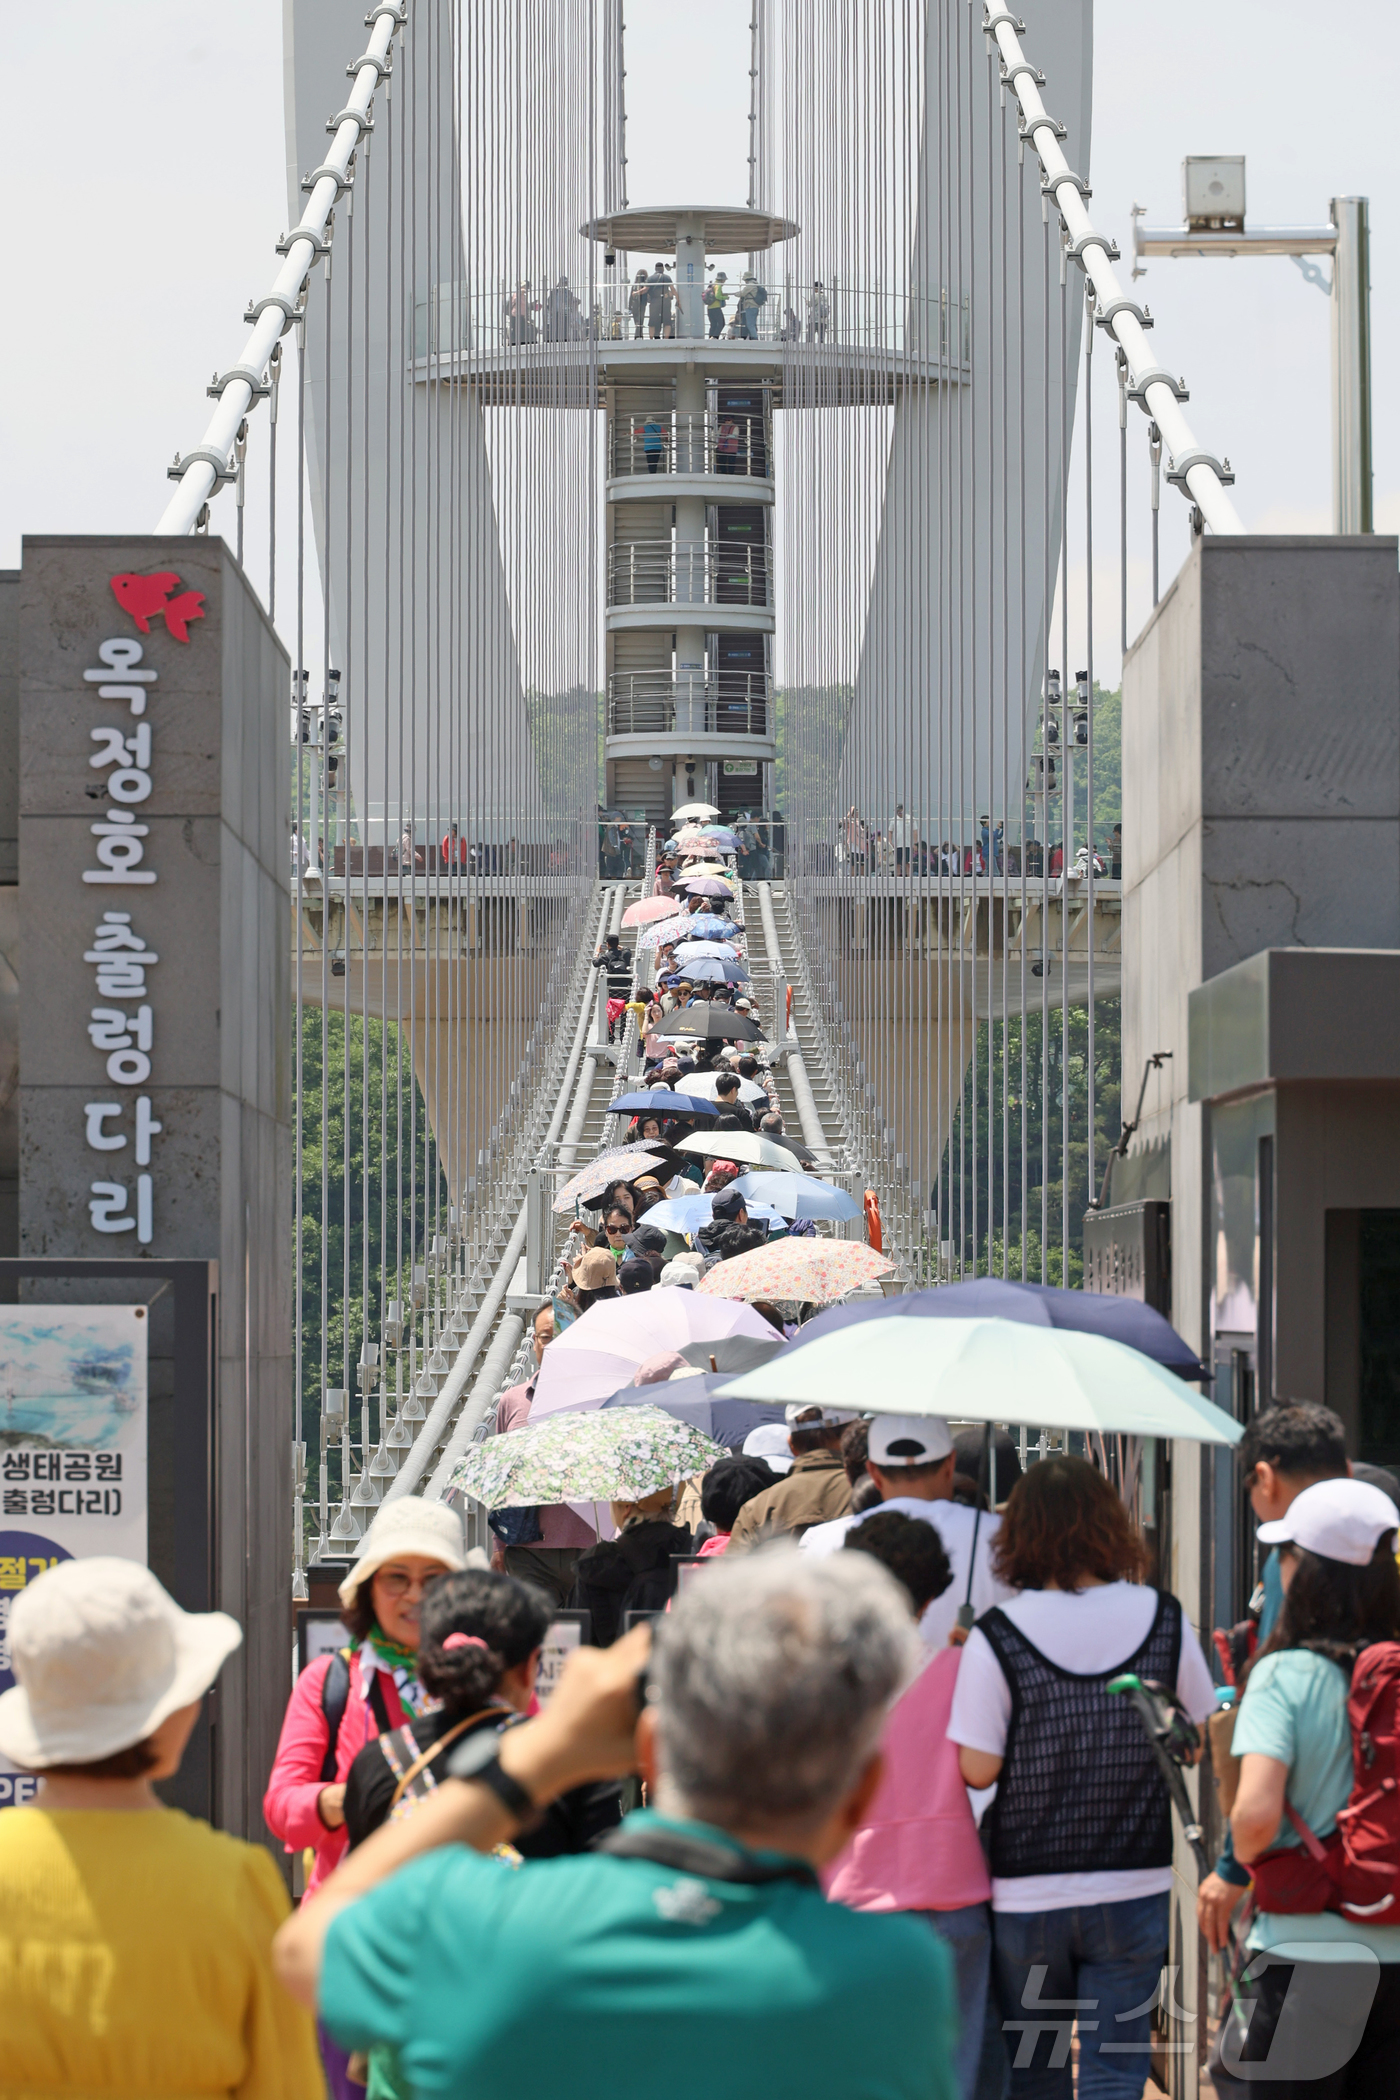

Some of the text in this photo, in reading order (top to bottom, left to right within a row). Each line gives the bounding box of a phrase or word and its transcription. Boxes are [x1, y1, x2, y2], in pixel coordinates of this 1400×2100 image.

[83, 638, 161, 1244] 옥정호 출렁다리
[2, 1453, 122, 1481] 생태공원
[3, 1488, 121, 1516] 출렁다리)
